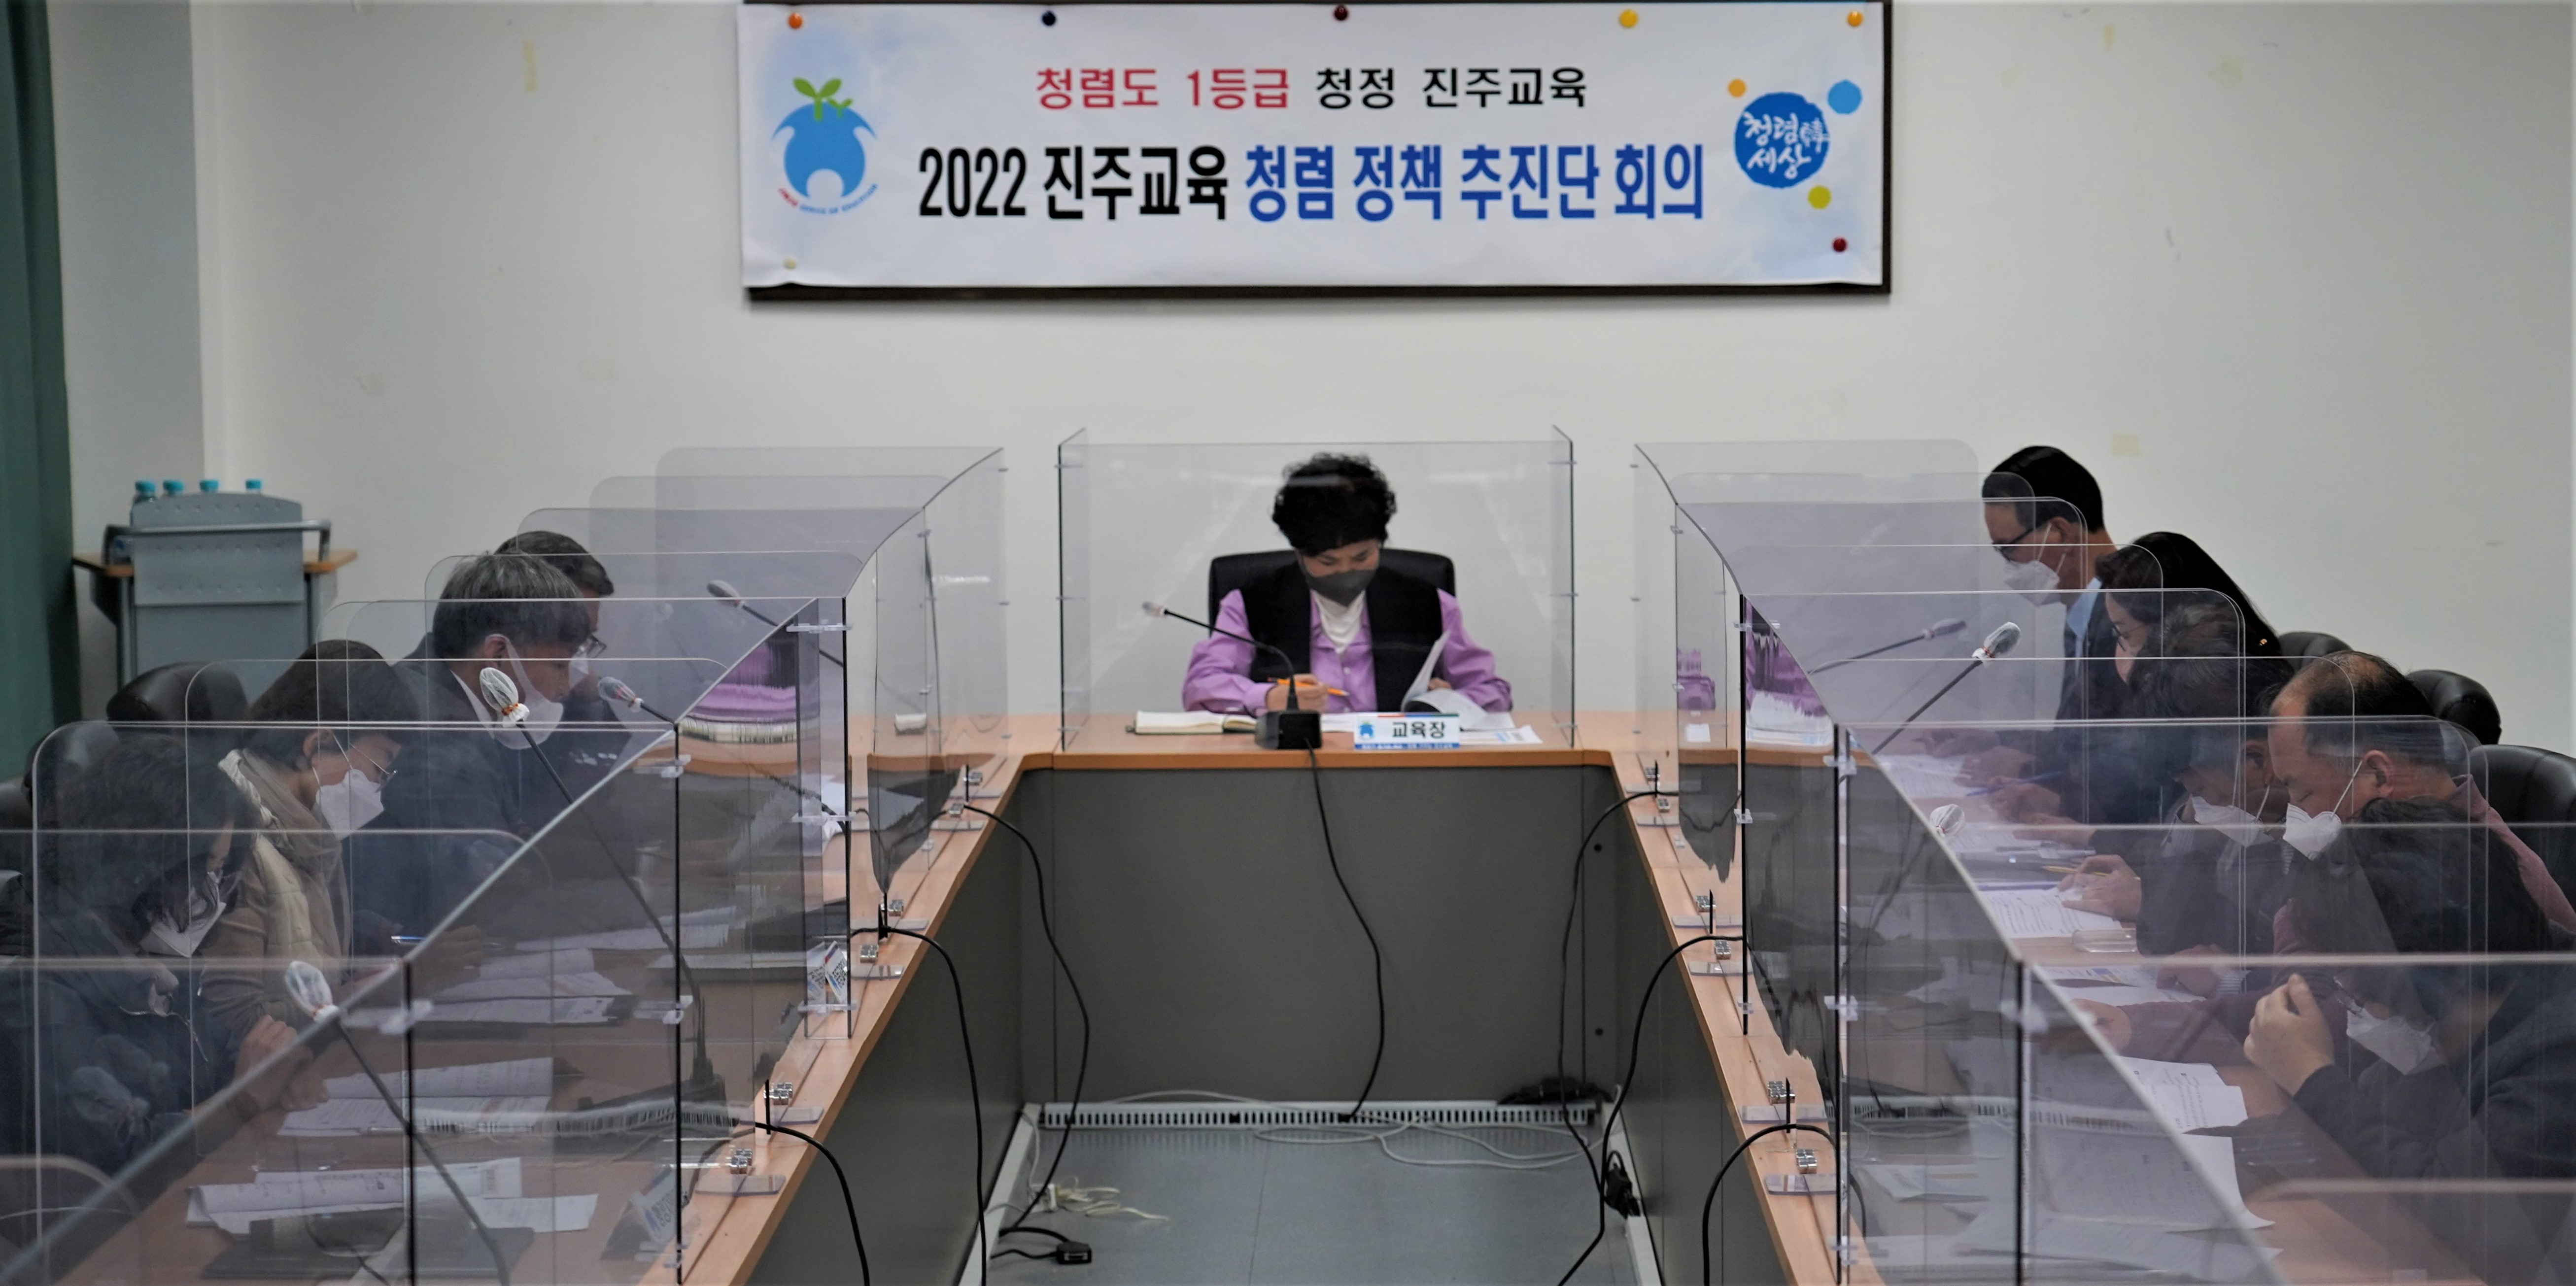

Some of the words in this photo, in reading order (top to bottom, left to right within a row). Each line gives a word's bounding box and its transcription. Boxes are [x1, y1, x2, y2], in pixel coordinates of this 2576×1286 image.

[1036, 67, 1159, 111] 청렴도
[1187, 68, 1289, 111] 1등급
[1316, 67, 1395, 110] 청정
[1423, 67, 1587, 109] 진주교육
[1747, 143, 1812, 179] 세상
[919, 147, 1027, 218] 2022
[1043, 145, 1229, 221] 진주교육
[1244, 144, 1335, 224] 청렴
[1352, 144, 1443, 223] 정책
[1460, 143, 1601, 221] 추진단
[1614, 143, 1704, 221] 회의
[1392, 721, 1445, 739] 교육장
